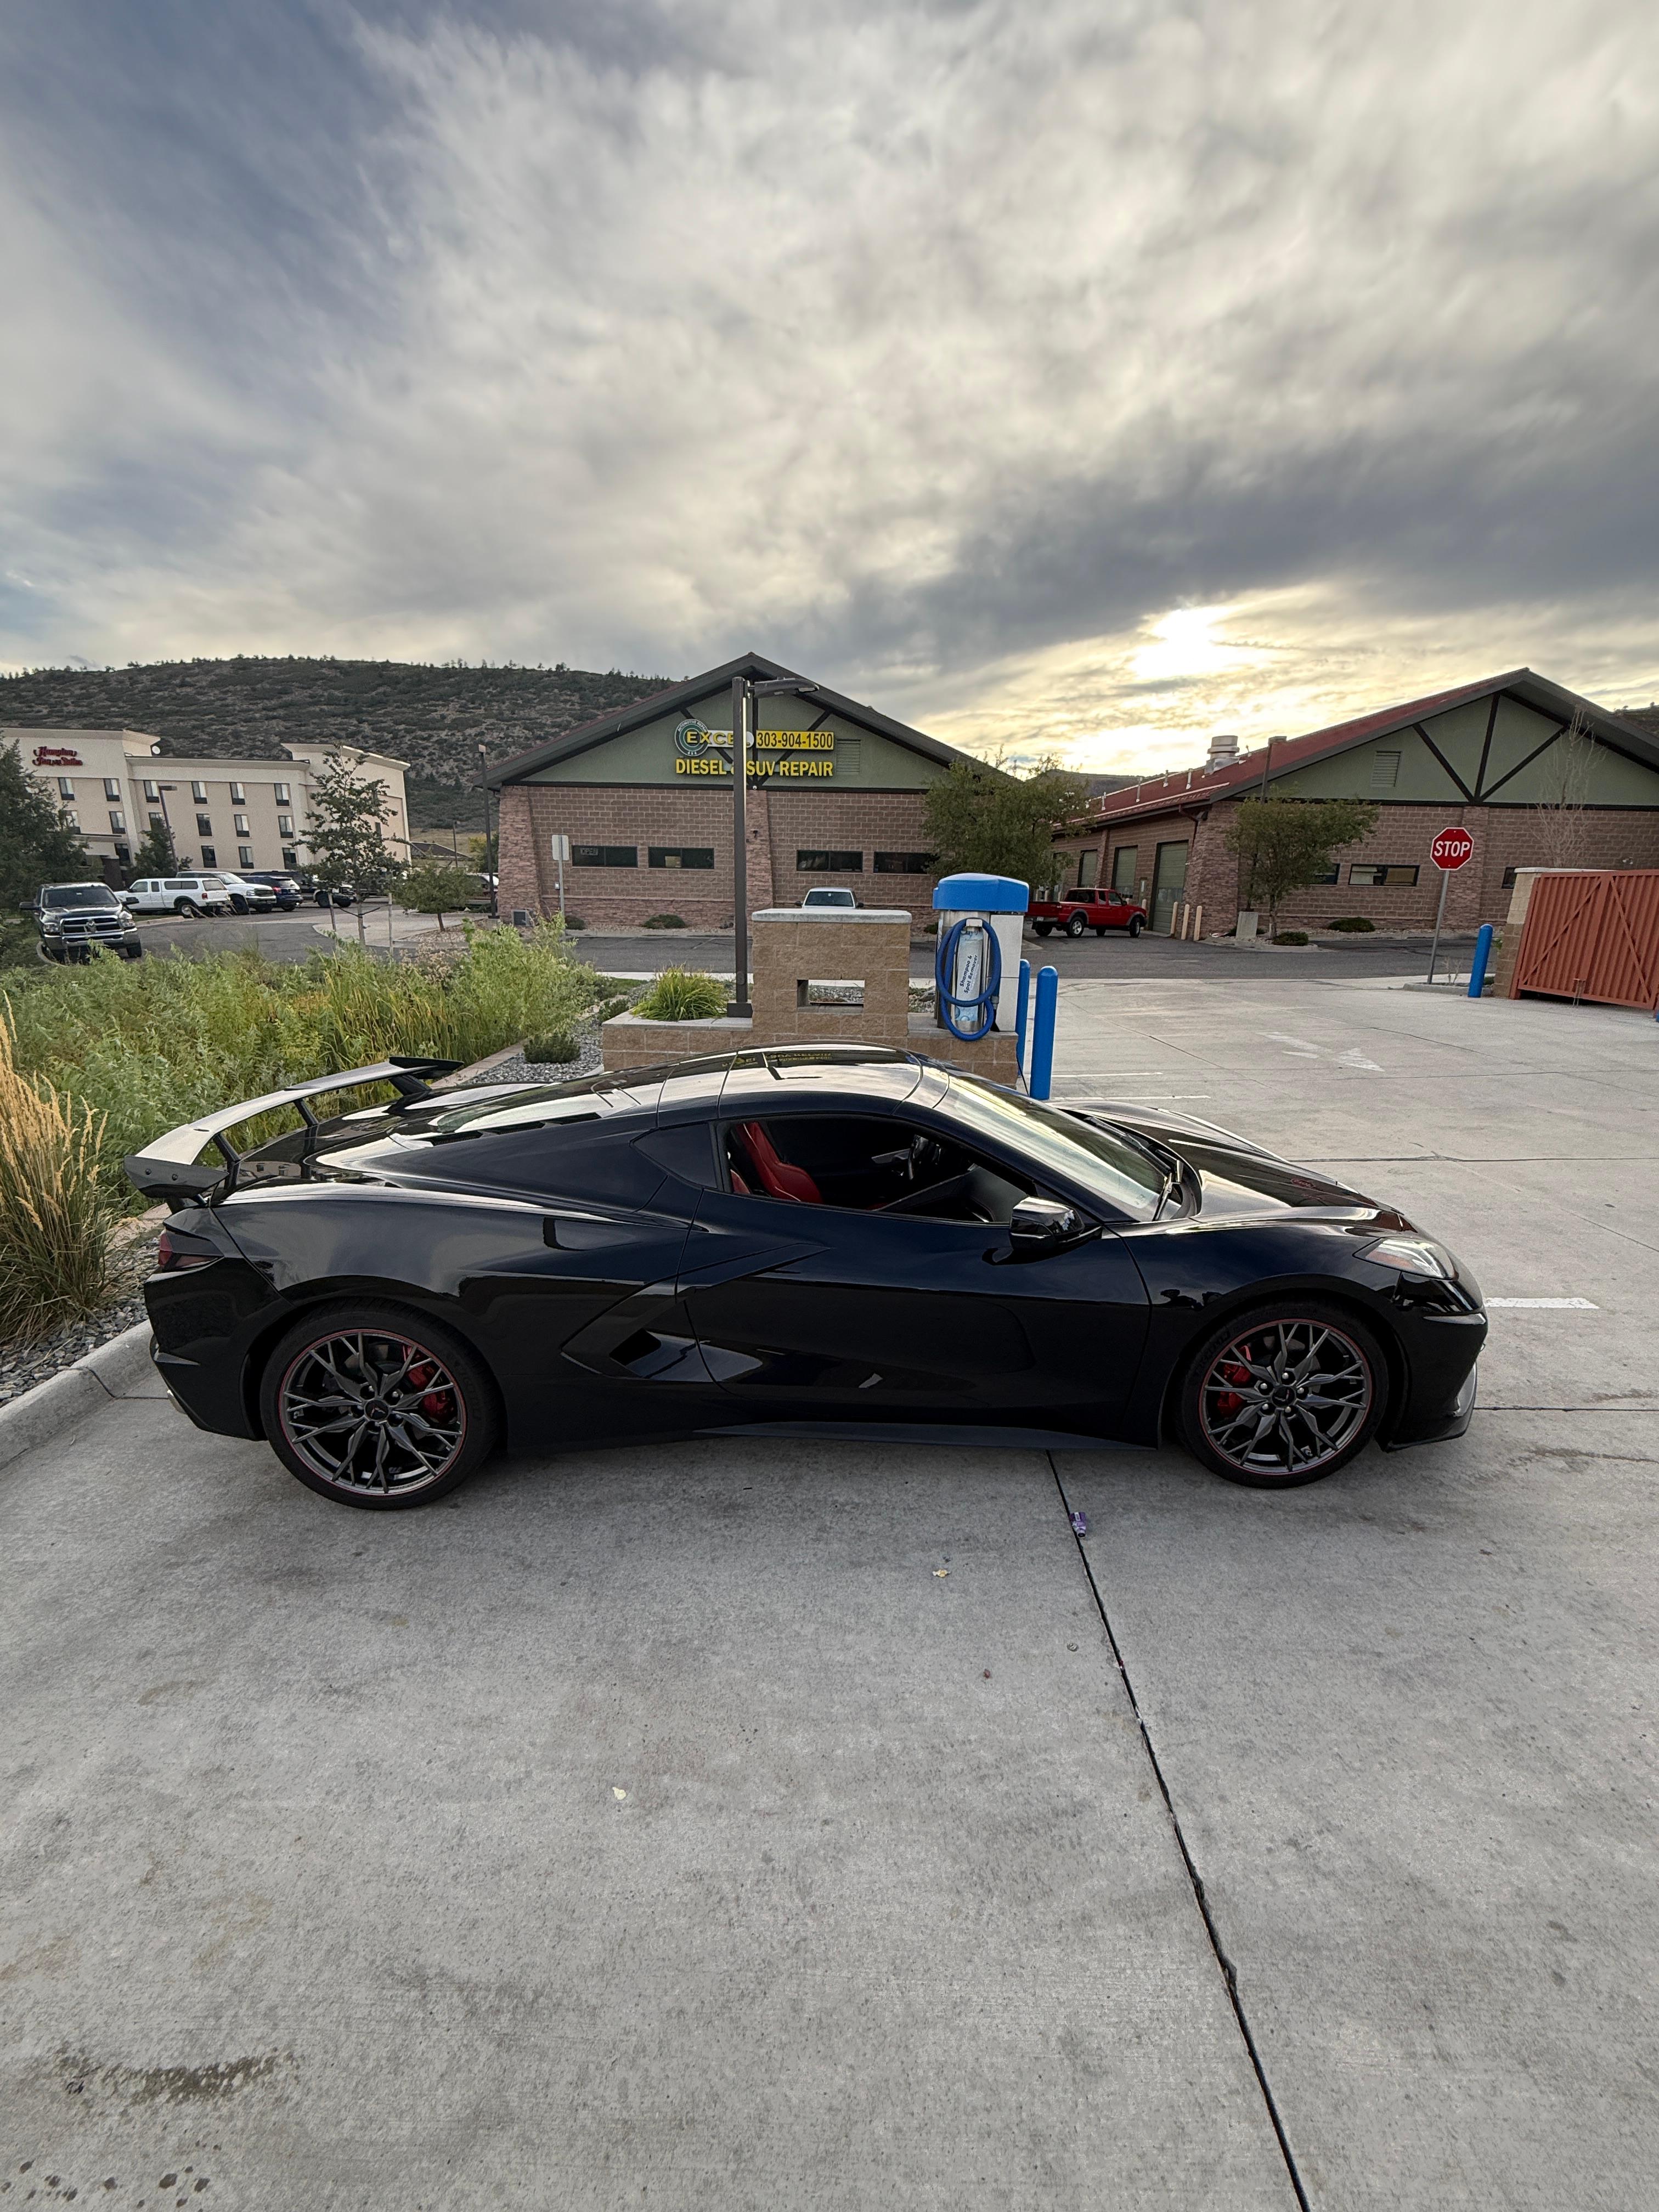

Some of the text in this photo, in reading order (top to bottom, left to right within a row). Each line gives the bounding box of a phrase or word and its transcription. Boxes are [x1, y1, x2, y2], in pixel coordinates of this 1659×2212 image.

[687, 731, 751, 746] EXCE
[757, 732, 833, 748] 303-904-1500
[676, 759, 727, 775] DIESEL
[746, 760, 775, 776] SUV
[780, 761, 833, 777] REPAIR
[1434, 841, 1470, 856] STOP
[960, 960, 971, 988] Shampoo
[968, 955, 978, 979] Remover
